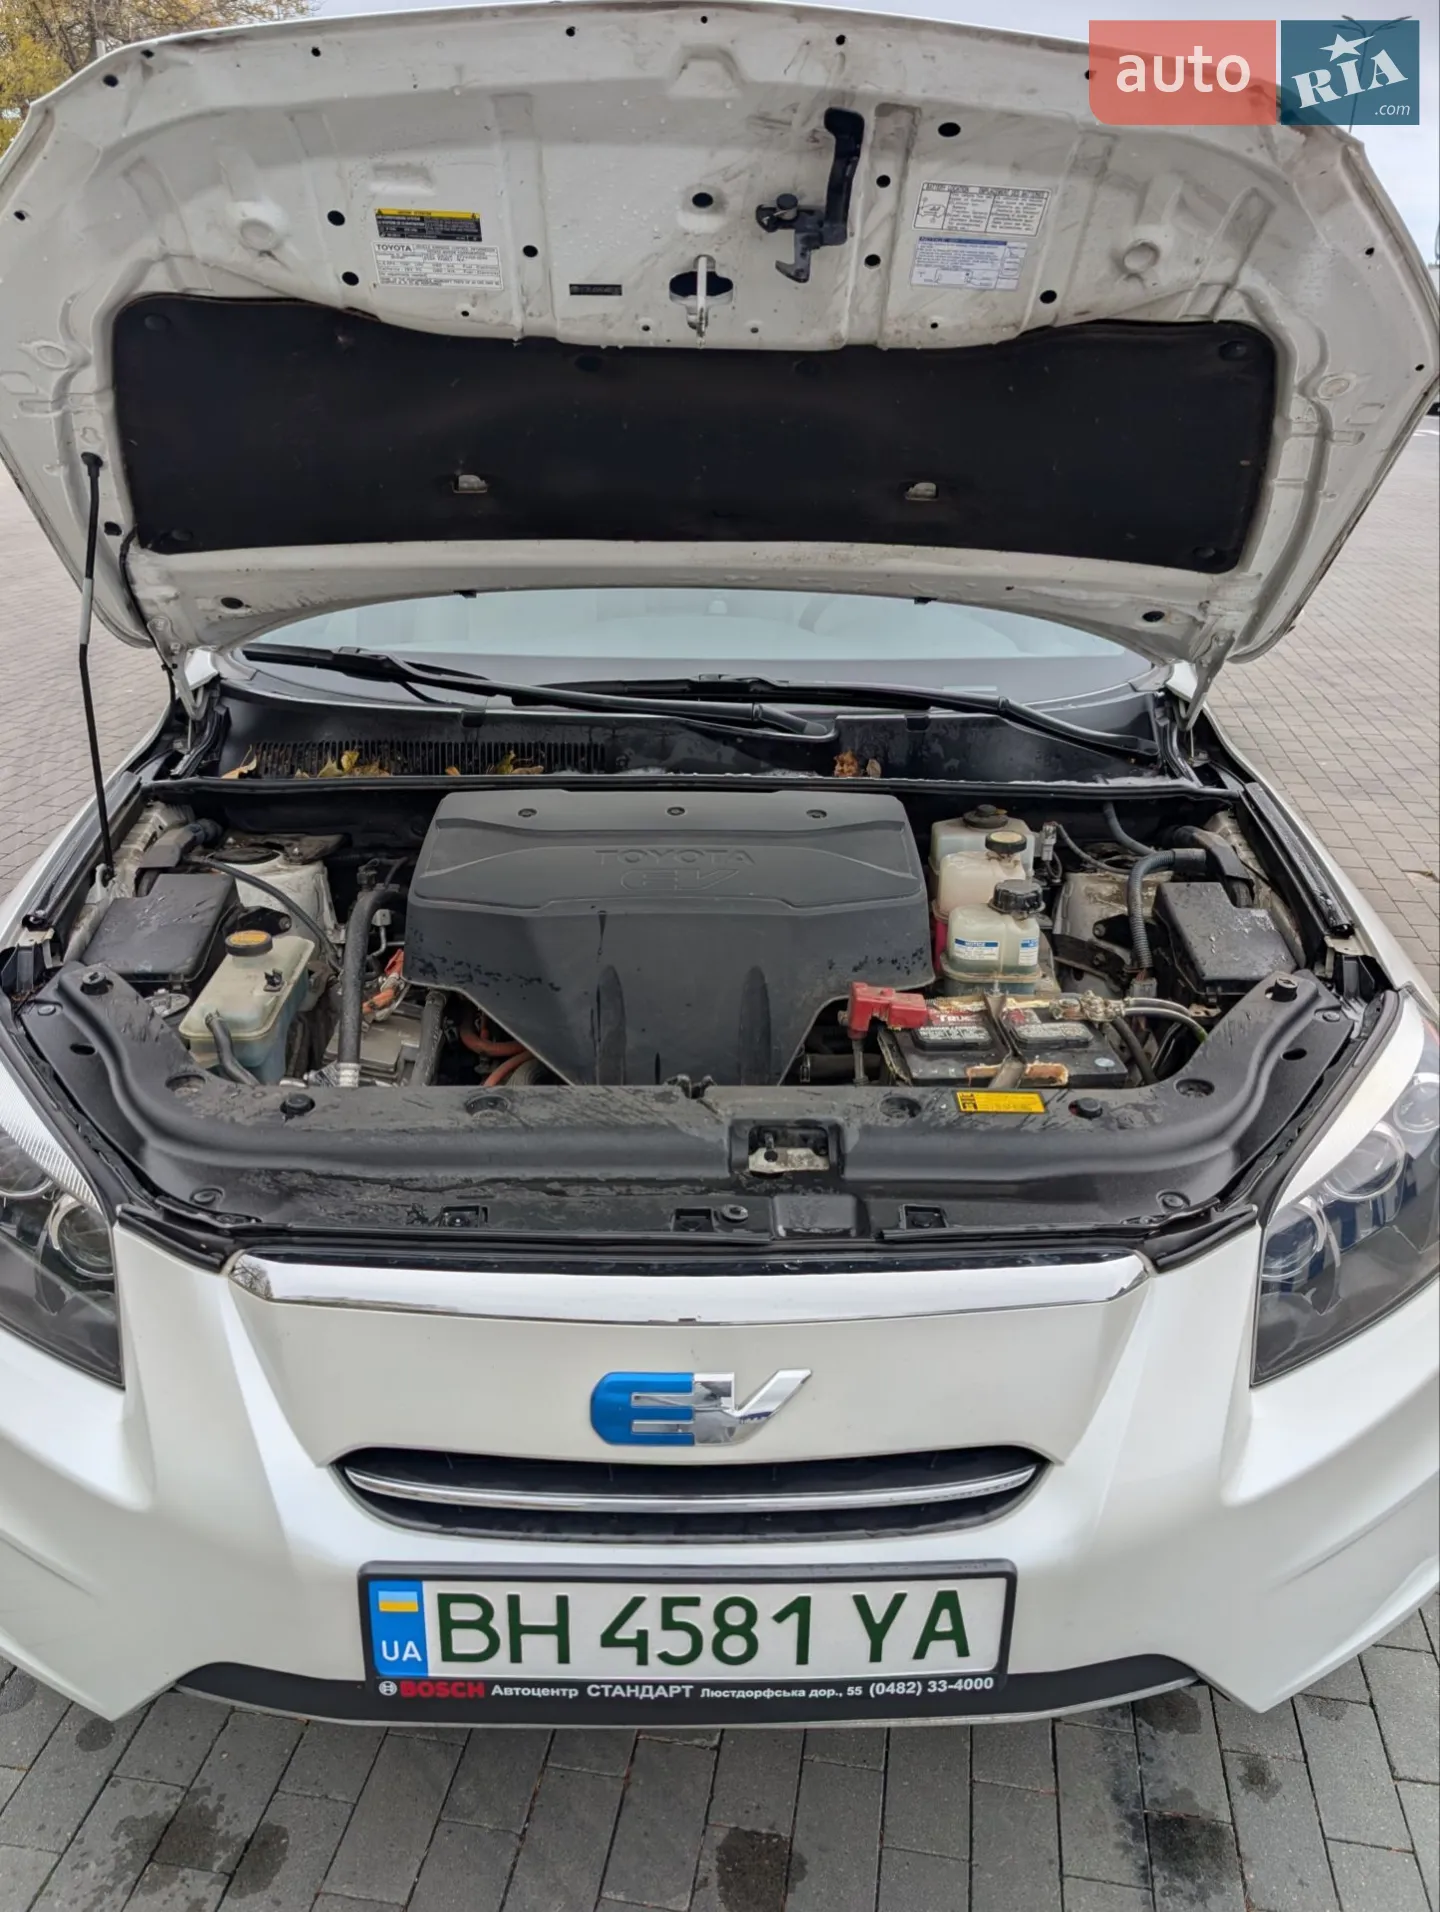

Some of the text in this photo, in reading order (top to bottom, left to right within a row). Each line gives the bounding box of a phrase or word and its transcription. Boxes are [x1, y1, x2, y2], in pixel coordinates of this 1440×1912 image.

[376, 244, 412, 252] TOYOTA
[595, 848, 755, 866] TOYOTA
[621, 868, 740, 891] EV
[590, 1368, 812, 1446] EV
[436, 1590, 971, 1666] BH 4581 YA
[381, 1639, 422, 1663] UA
[400, 1677, 994, 1700] BOSCH Автоцентр СТАНДАРТ Люстдорфська дор., 55 (0482) 33-4000
